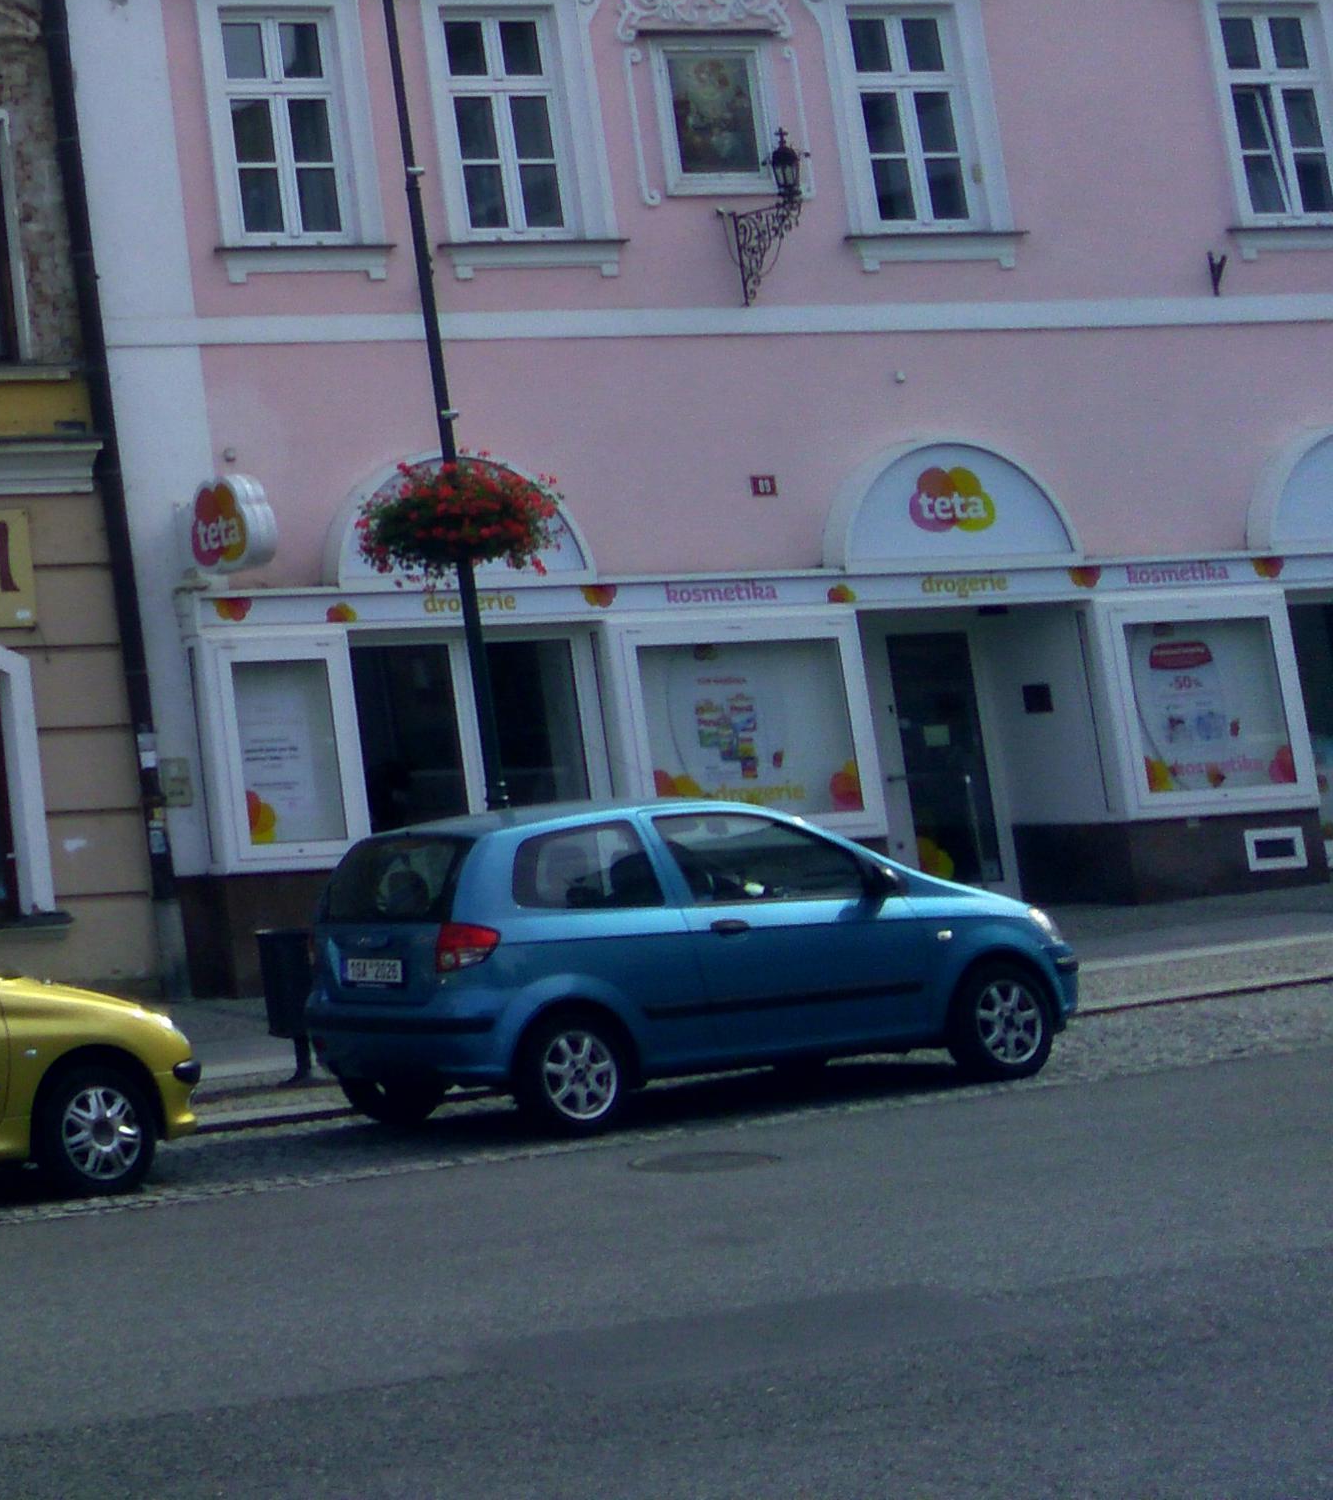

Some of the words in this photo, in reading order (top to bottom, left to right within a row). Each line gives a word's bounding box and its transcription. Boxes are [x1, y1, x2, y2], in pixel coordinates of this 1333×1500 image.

[919, 491, 987, 520] teta
[197, 516, 241, 551] teta
[1126, 561, 1229, 585] kosmetika
[664, 581, 778, 604] kosmetika
[921, 575, 1009, 599] drogerie
[423, 591, 517, 613] droerie
